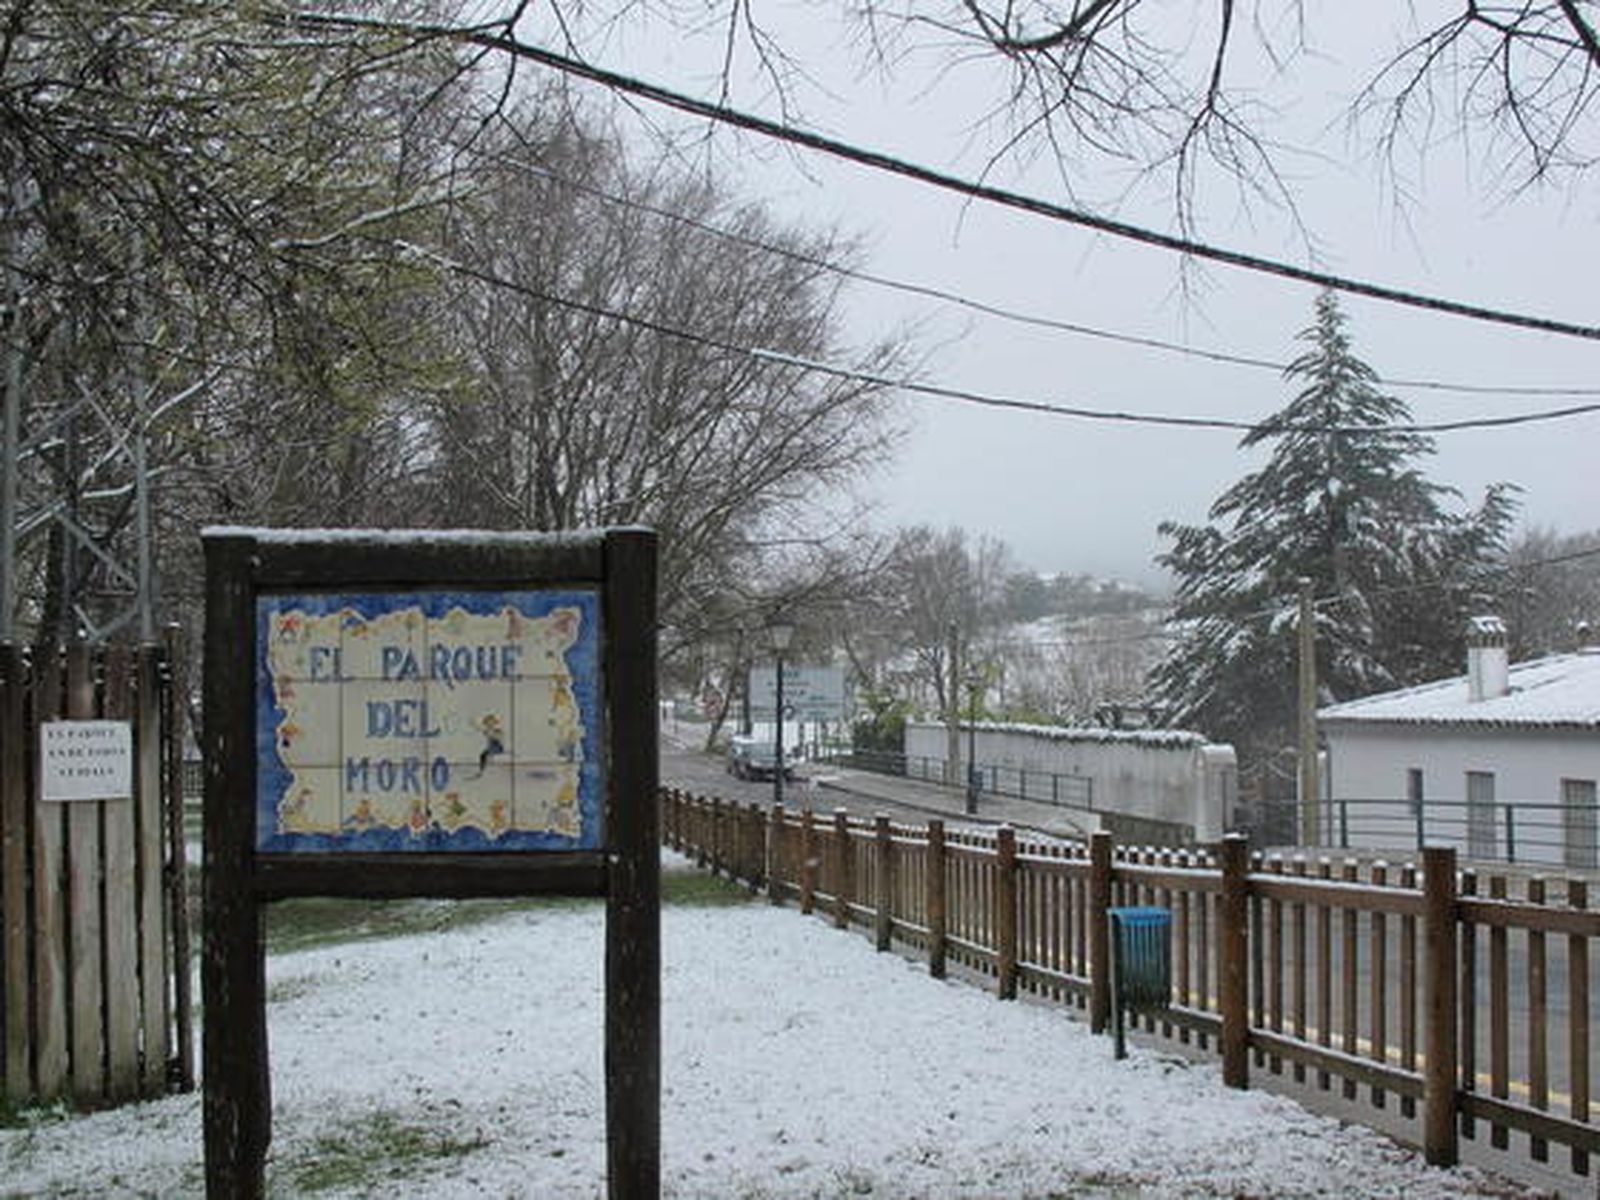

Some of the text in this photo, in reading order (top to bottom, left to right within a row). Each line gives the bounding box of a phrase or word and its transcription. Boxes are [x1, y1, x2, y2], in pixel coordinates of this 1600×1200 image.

[310, 645, 522, 689] EL PARQUE
[366, 700, 442, 739] DEL
[347, 756, 450, 793] MORO
